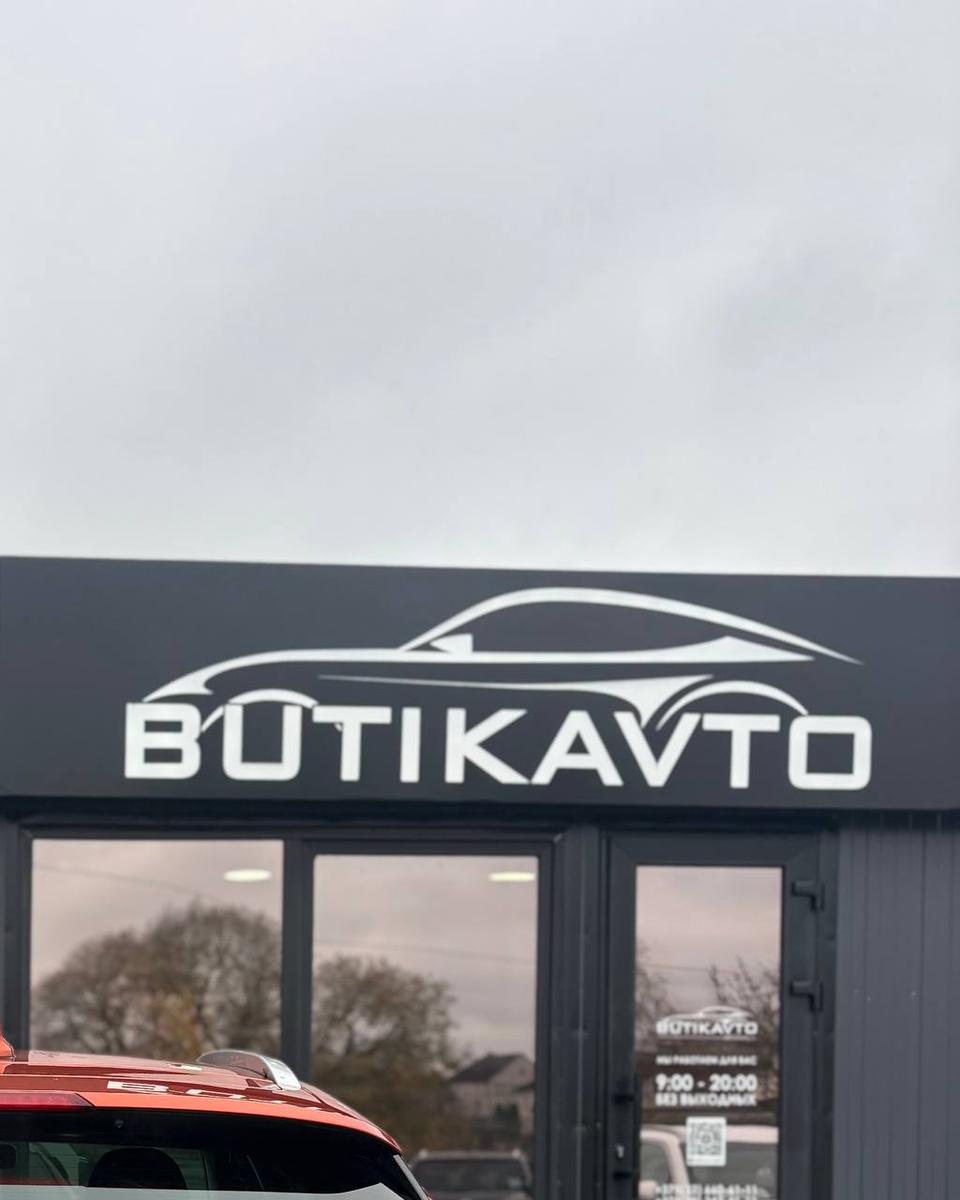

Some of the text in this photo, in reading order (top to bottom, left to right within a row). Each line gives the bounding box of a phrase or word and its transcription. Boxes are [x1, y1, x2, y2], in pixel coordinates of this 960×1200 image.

[125, 701, 872, 790] BUTIKAVTO
[655, 1021, 759, 1036] BUTIKAVTO
[655, 1073, 694, 1091] 9:00
[709, 1073, 758, 1091] 20:00
